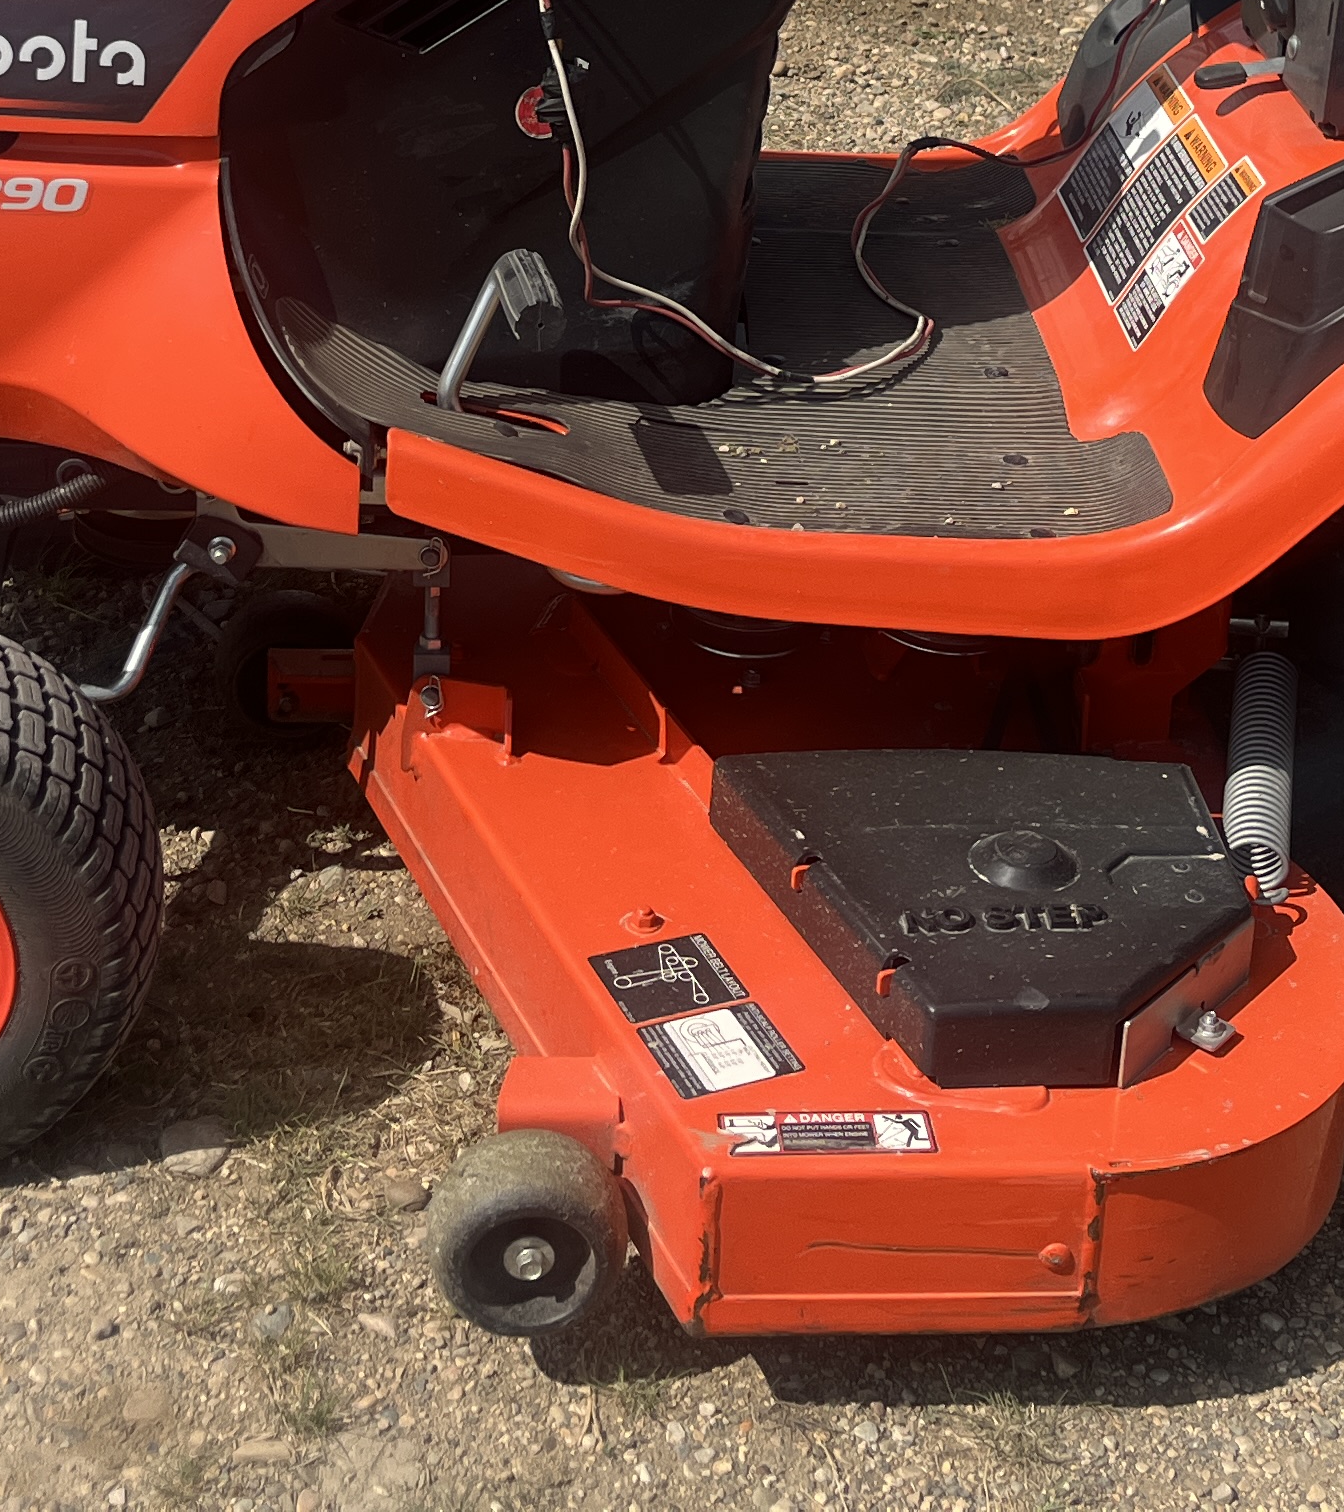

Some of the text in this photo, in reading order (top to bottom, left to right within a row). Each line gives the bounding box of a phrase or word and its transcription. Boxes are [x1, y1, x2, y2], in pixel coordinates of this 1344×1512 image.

[1189, 133, 1217, 174] WARNING
[899, 902, 1109, 937] NO STEP
[799, 1112, 865, 1123] DANGER
